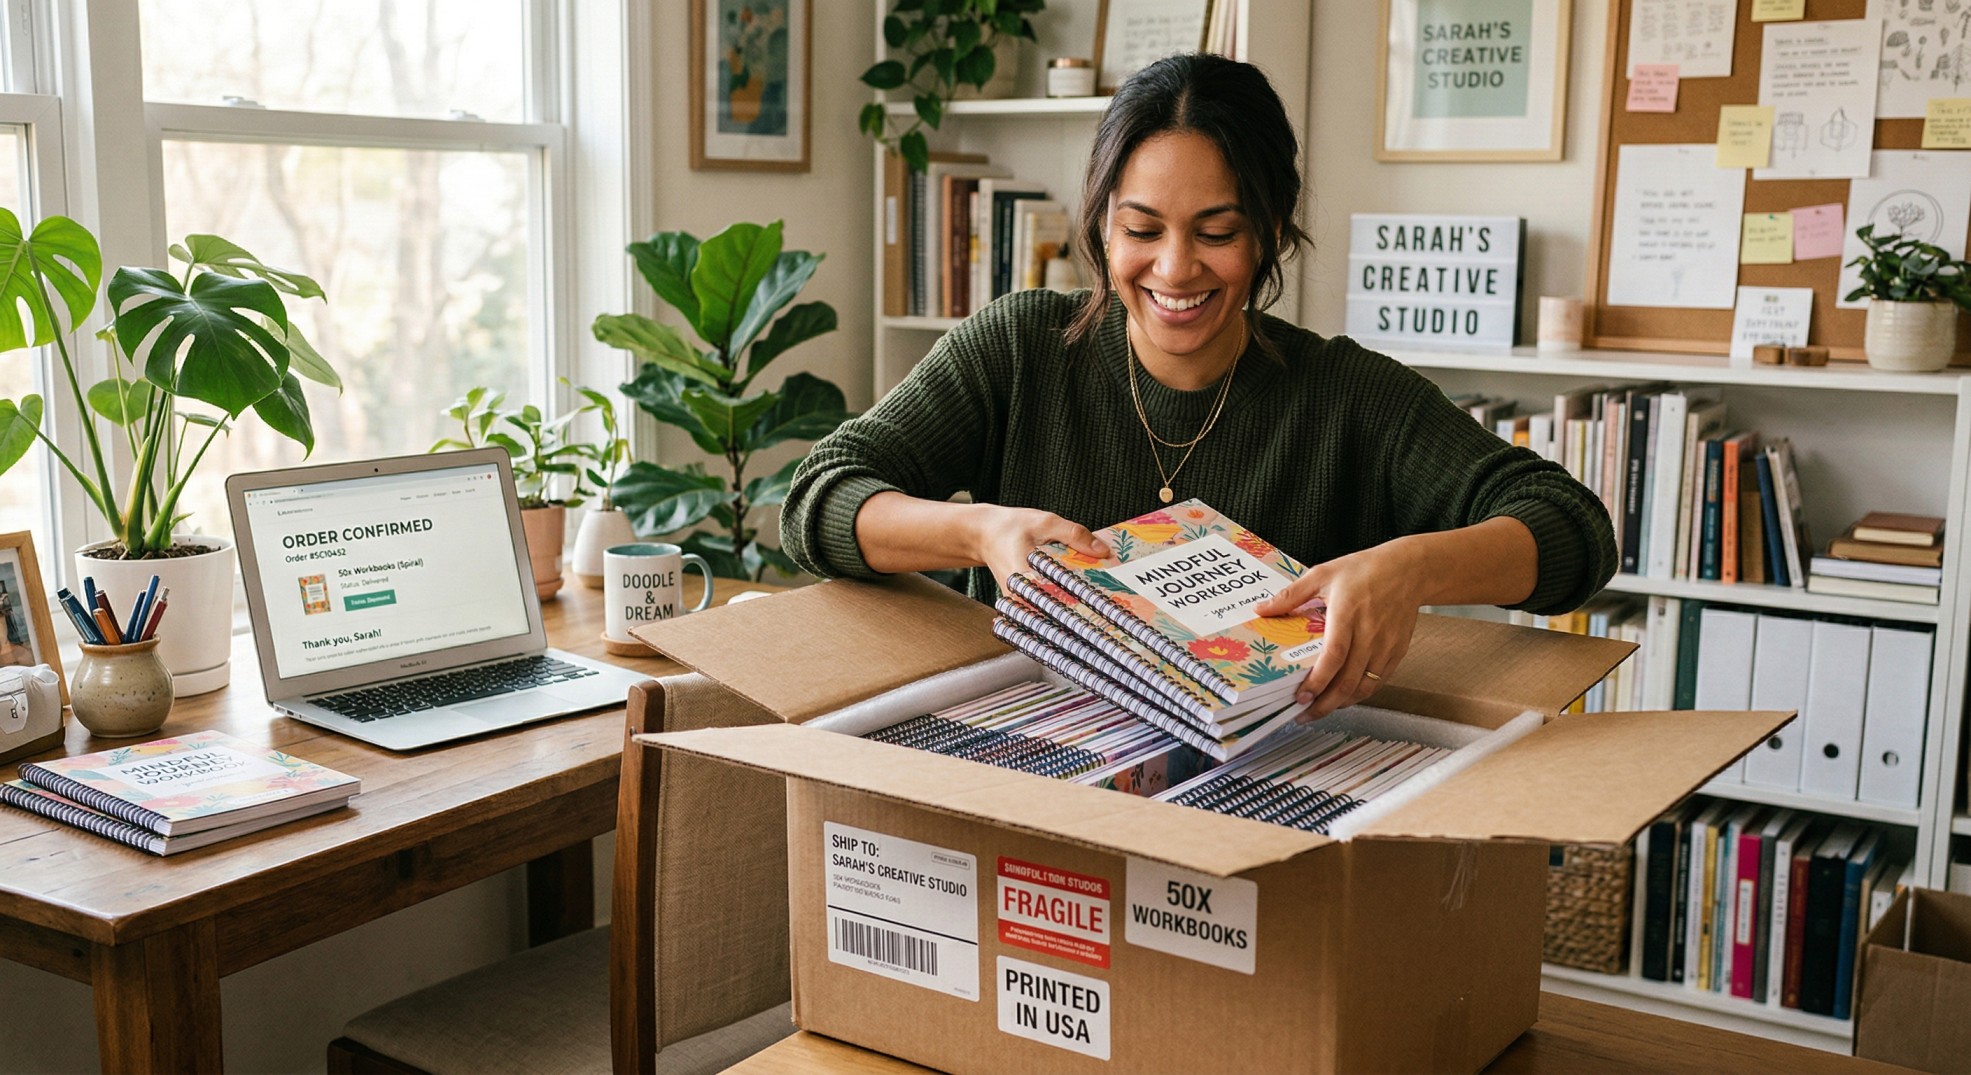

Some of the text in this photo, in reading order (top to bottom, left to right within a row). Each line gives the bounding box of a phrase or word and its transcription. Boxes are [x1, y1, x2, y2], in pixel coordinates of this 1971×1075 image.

[1422, 22, 1511, 42] SARAH'S
[1422, 46, 1522, 65] CREATIVE
[1428, 71, 1504, 89] STUDIO
[1376, 224, 1491, 253] SARAH'S
[1362, 265, 1499, 295] CREATIVE
[1378, 306, 1479, 336] STUDIO
[282, 518, 433, 550] ORDER CONFIRMED
[285, 552, 308, 563] Order
[338, 568, 352, 577] 50x
[353, 562, 395, 575] Workbooks
[1135, 548, 1231, 585] MINDFUL
[623, 571, 674, 588] DOODLE
[1155, 558, 1246, 598] JOURNEY
[1168, 570, 1268, 609] WORKBOOK
[625, 603, 674, 620] DREAM
[645, 590, 655, 604] &
[1211, 603, 1237, 619] your
[302, 628, 382, 650] Thank you, Sarah!
[120, 751, 225, 775] MINDFUL
[832, 834, 880, 858] SHIP TO:
[832, 853, 875, 875] SARAH'S
[877, 864, 926, 887] CREATIVE
[928, 878, 967, 897] STUDIO
[1004, 885, 1103, 934] FRAGILE
[1167, 880, 1213, 915] 50X
[1132, 903, 1248, 950] WORKBOOKS
[1006, 968, 1100, 1015] PRINTED
[1016, 1001, 1091, 1044] IN USA
